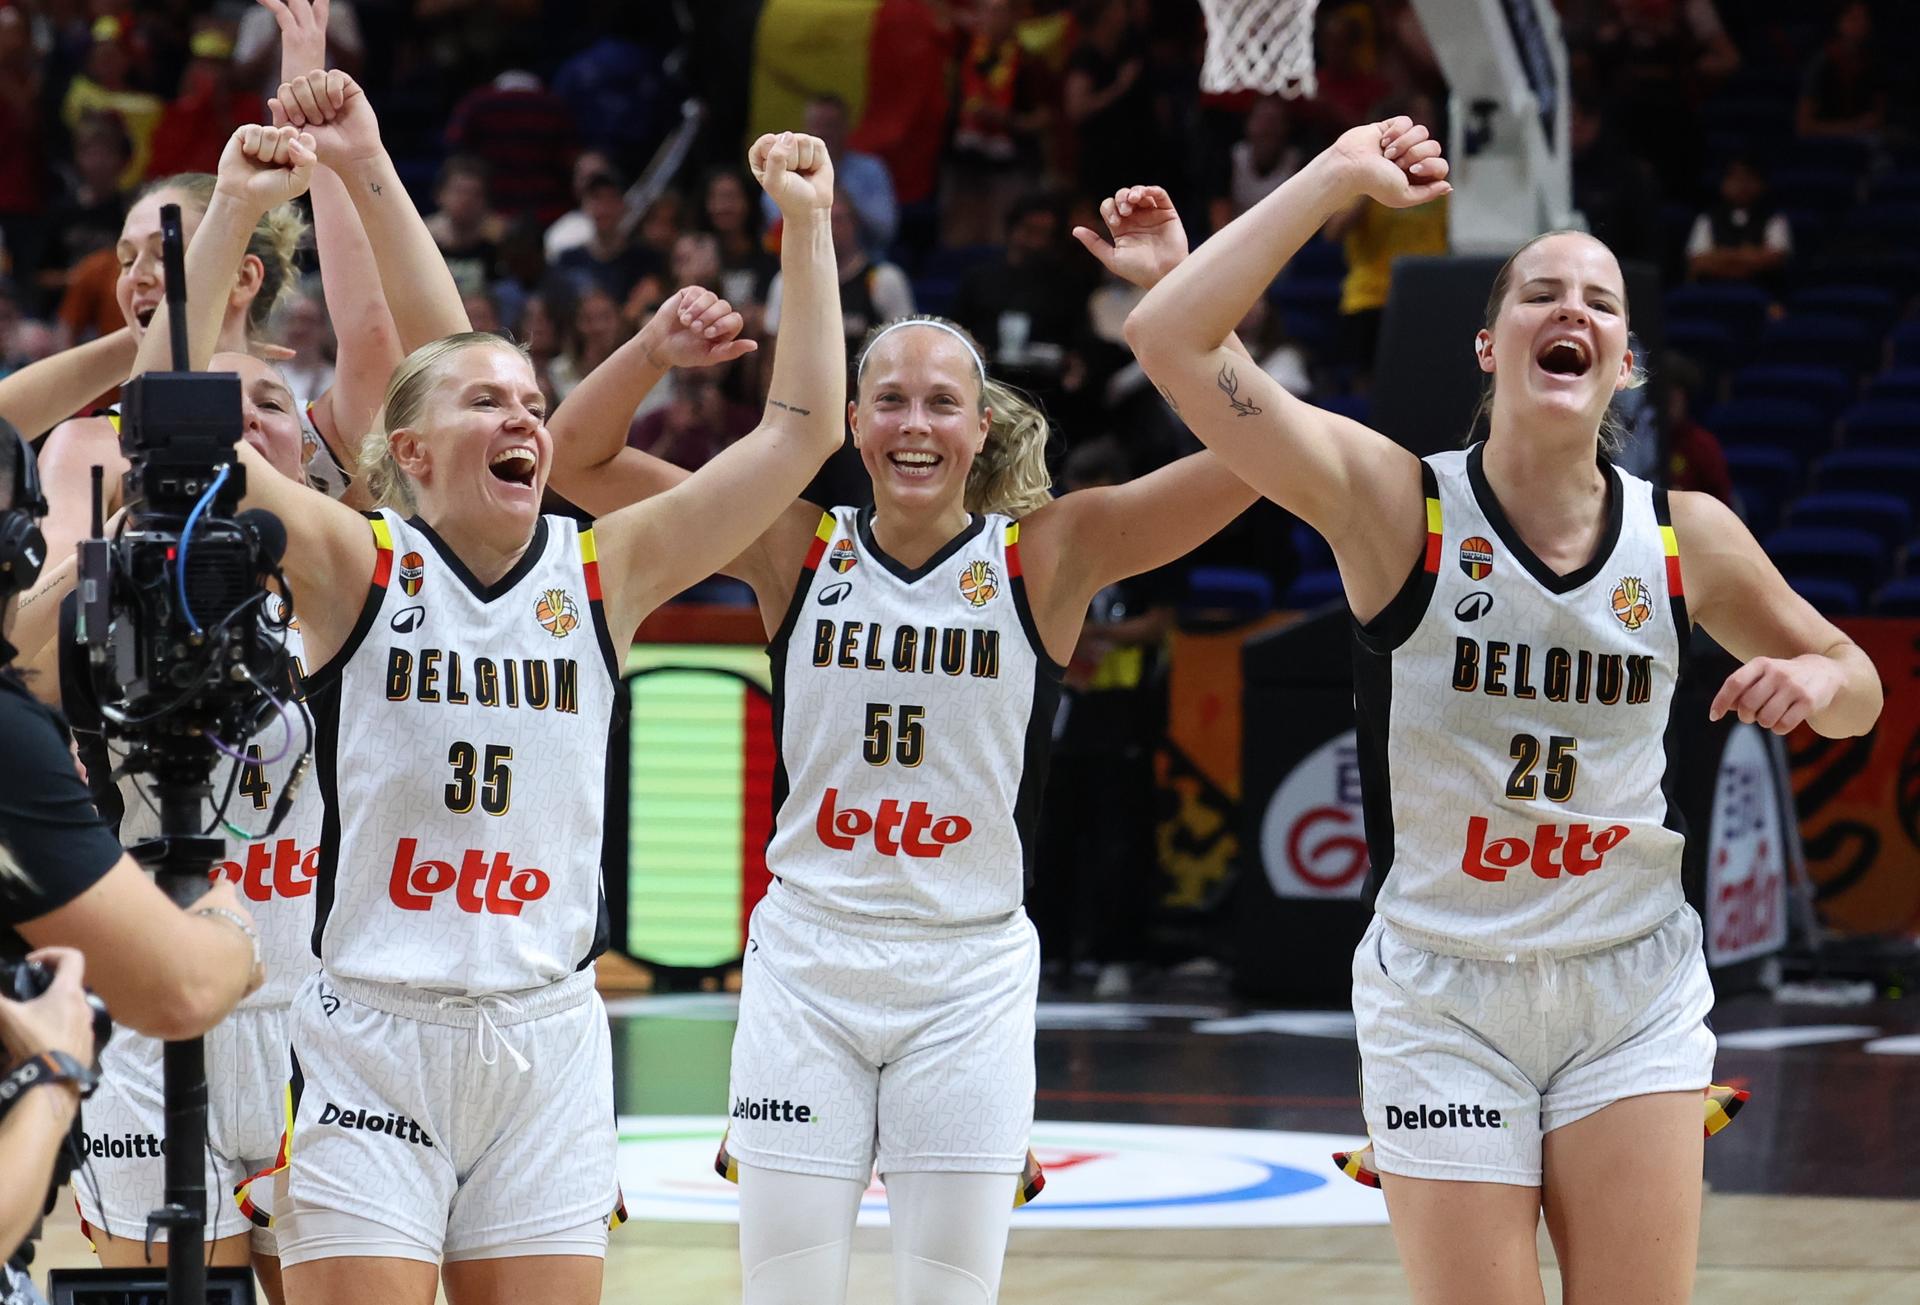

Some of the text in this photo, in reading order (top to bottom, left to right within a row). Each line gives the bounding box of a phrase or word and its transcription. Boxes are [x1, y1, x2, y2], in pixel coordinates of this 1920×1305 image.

[386, 646, 578, 715] BELGIUM
[813, 619, 1000, 679] BELGIUM
[1452, 636, 1654, 705] BELGIUM
[863, 702, 925, 768] 55
[1505, 733, 1578, 803] 25
[238, 744, 271, 810] 4
[444, 741, 513, 817] 35
[816, 787, 973, 858] Lotto
[1461, 816, 1630, 882] Lotto
[388, 837, 551, 917] Lotto
